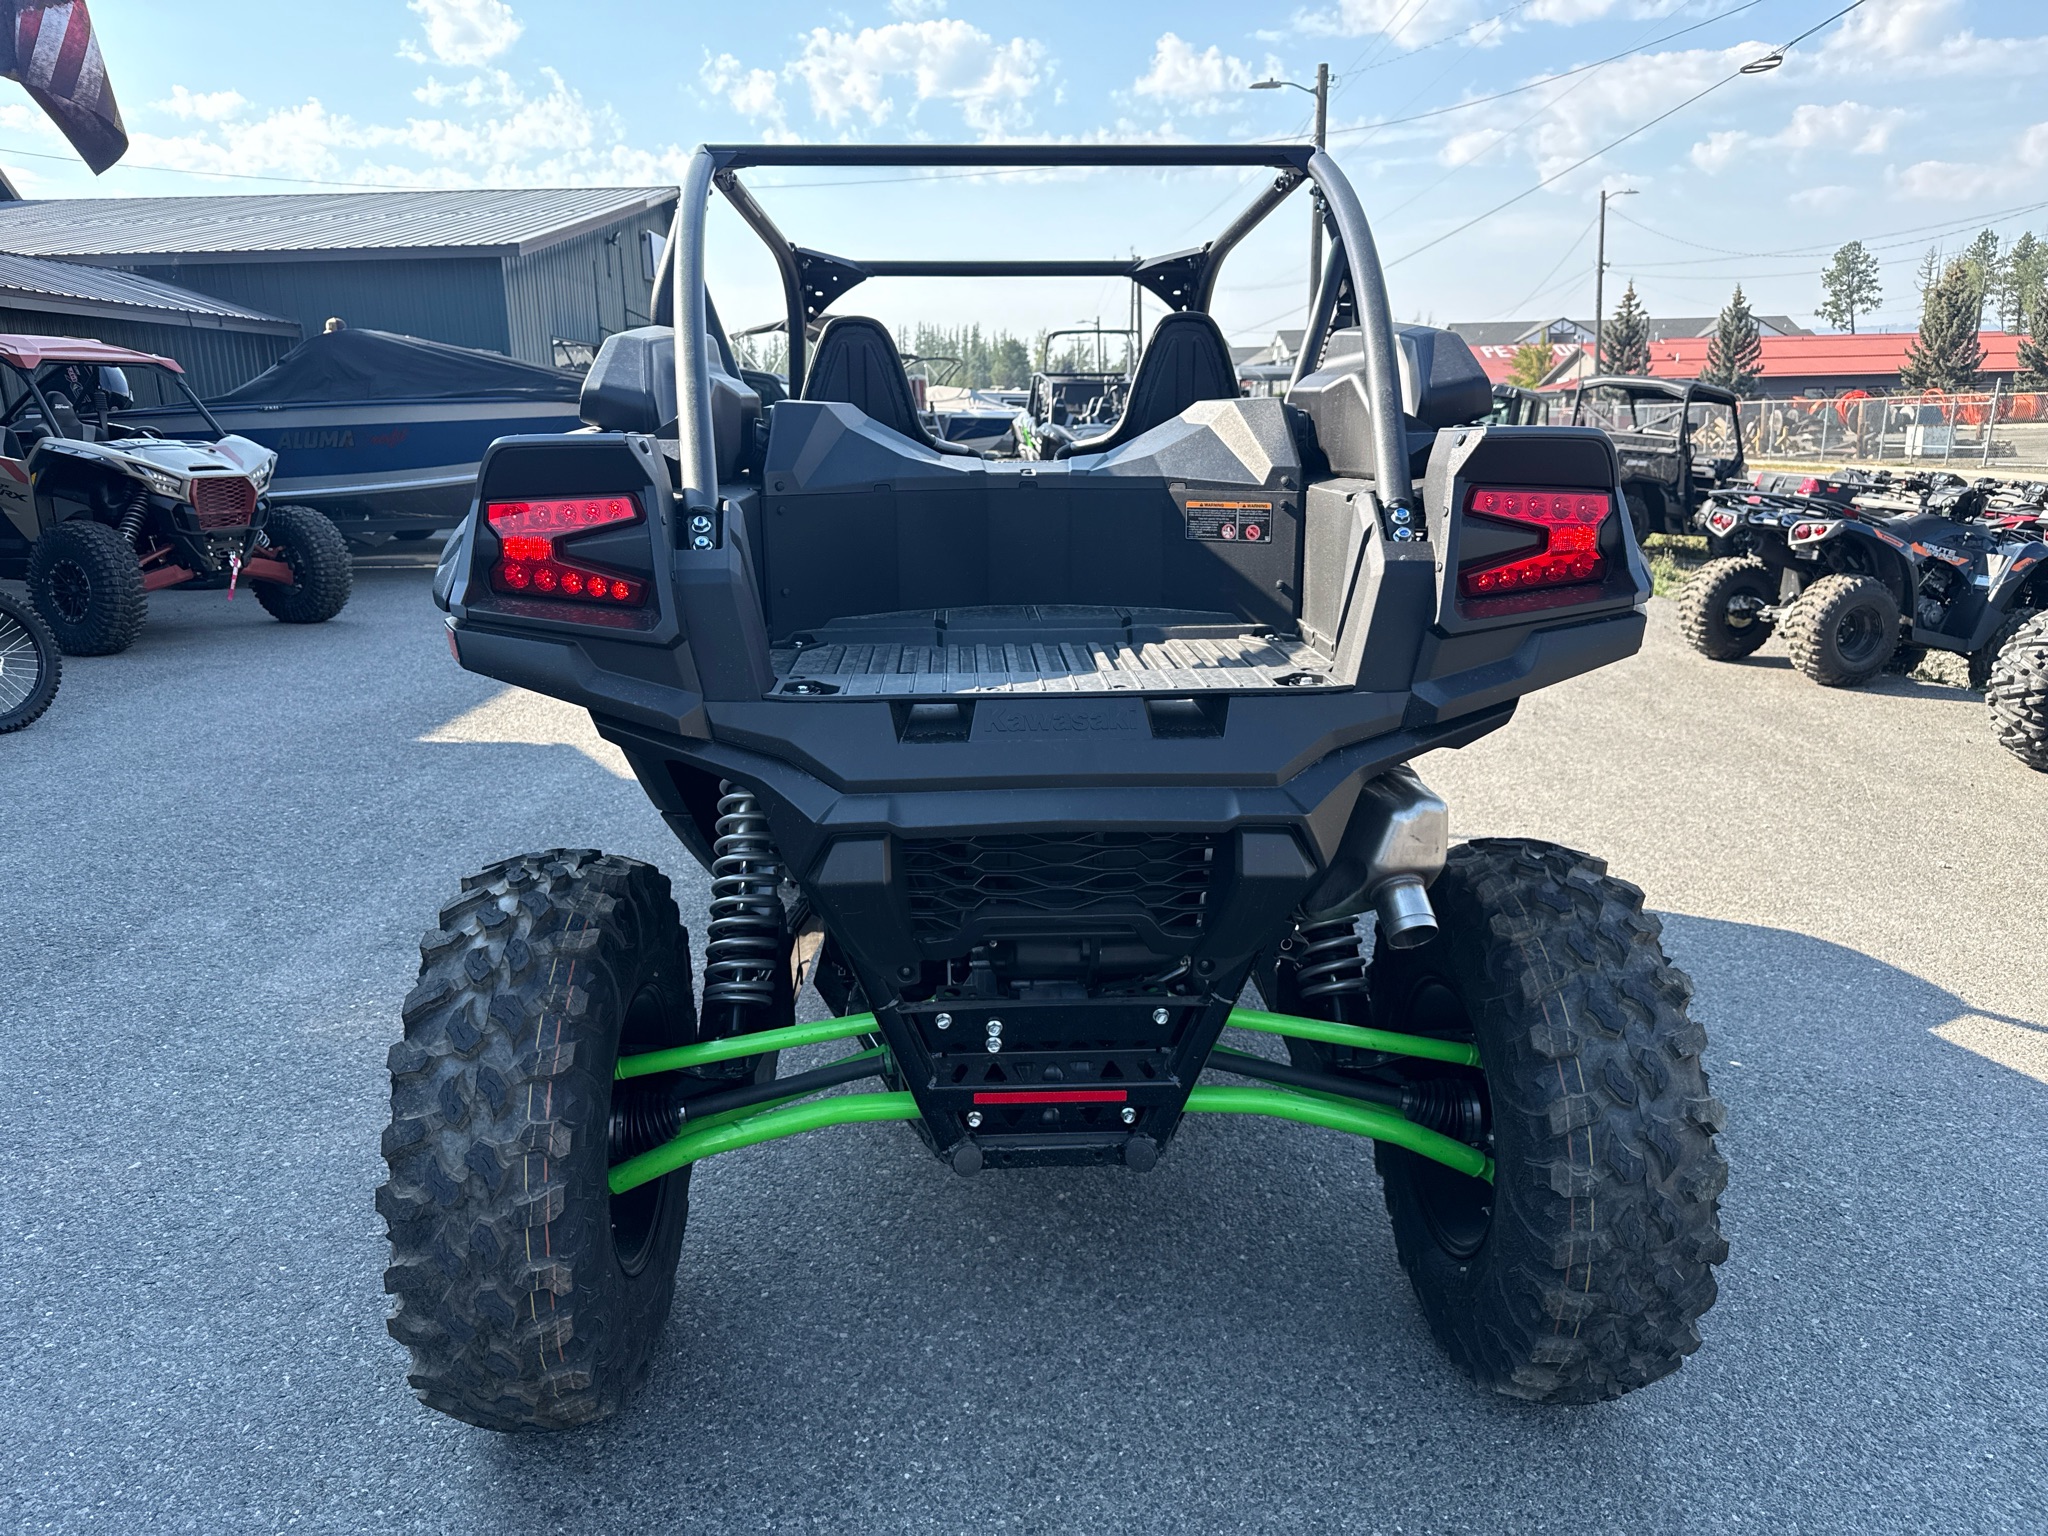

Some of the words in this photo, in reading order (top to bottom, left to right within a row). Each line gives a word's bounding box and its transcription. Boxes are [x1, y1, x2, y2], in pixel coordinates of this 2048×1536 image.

[1480, 344, 1521, 358] PET
[277, 429, 355, 449] ALUMA
[1922, 541, 1957, 556] BRUTE
[1926, 549, 1960, 562] FORCE
[984, 707, 1137, 732] Kawasaki
